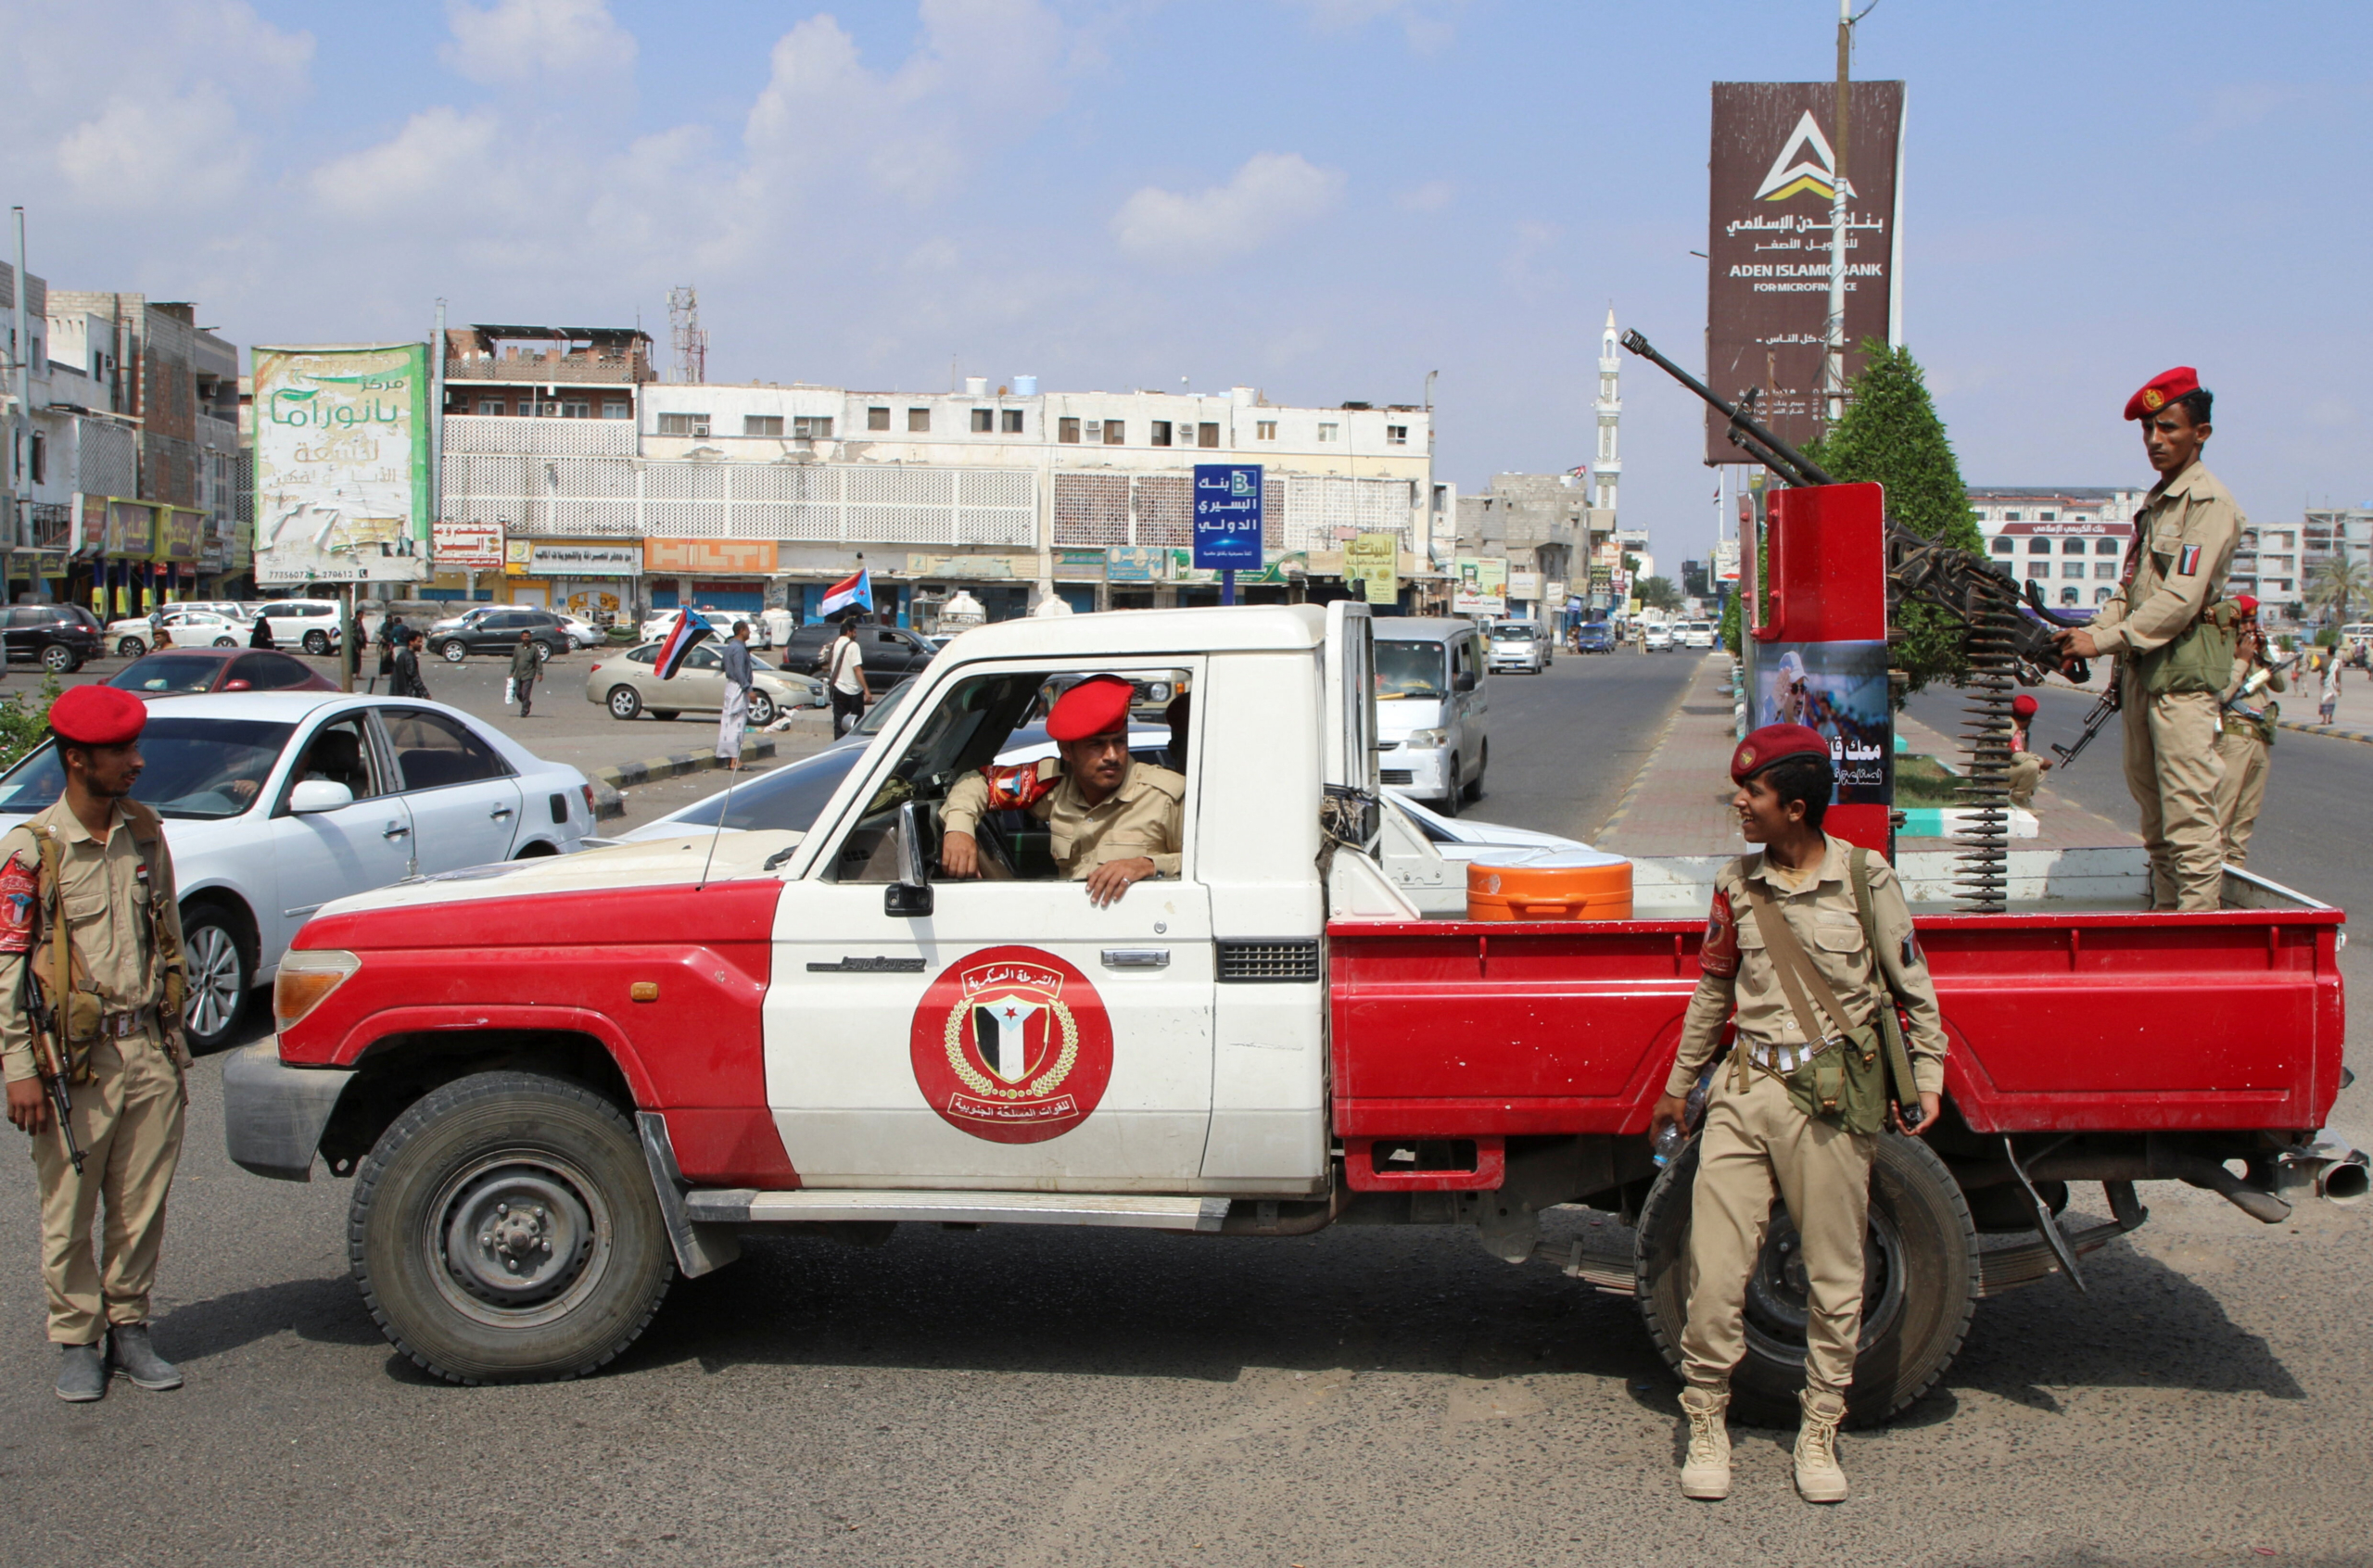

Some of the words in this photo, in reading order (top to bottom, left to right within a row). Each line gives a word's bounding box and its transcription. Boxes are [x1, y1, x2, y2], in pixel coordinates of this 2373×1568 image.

[1725, 214, 1794, 237] الإسلامي
[1796, 215, 1834, 234] دن
[1754, 237, 1800, 252] الأصغر
[1729, 265, 1772, 277] ADEN
[1754, 283, 1776, 292] FOR
[1778, 282, 1857, 292] MICROFINCE
[1765, 334, 1798, 345] الناس
[1800, 334, 1817, 344] كل
[362, 379, 404, 391] مركز
[271, 387, 398, 429] بانوراما
[1199, 477, 1229, 492] بنك
[1199, 499, 1256, 514] البسيري
[454, 525, 498, 537] مطعم
[1199, 519, 1256, 534] الدولي
[2033, 525, 2062, 534] الإسلامي
[2063, 525, 2091, 534] الكريمي
[2092, 525, 2105, 534] بنك
[653, 543, 769, 567] HILTI
[269, 571, 314, 580] 77756072
[1845, 740, 1882, 761] معك
[969, 967, 1014, 991] العسكرية
[1016, 969, 1057, 988] الشرطة
[955, 1098, 994, 1117] الجنوبية
[1038, 1100, 1071, 1117] للقوات
